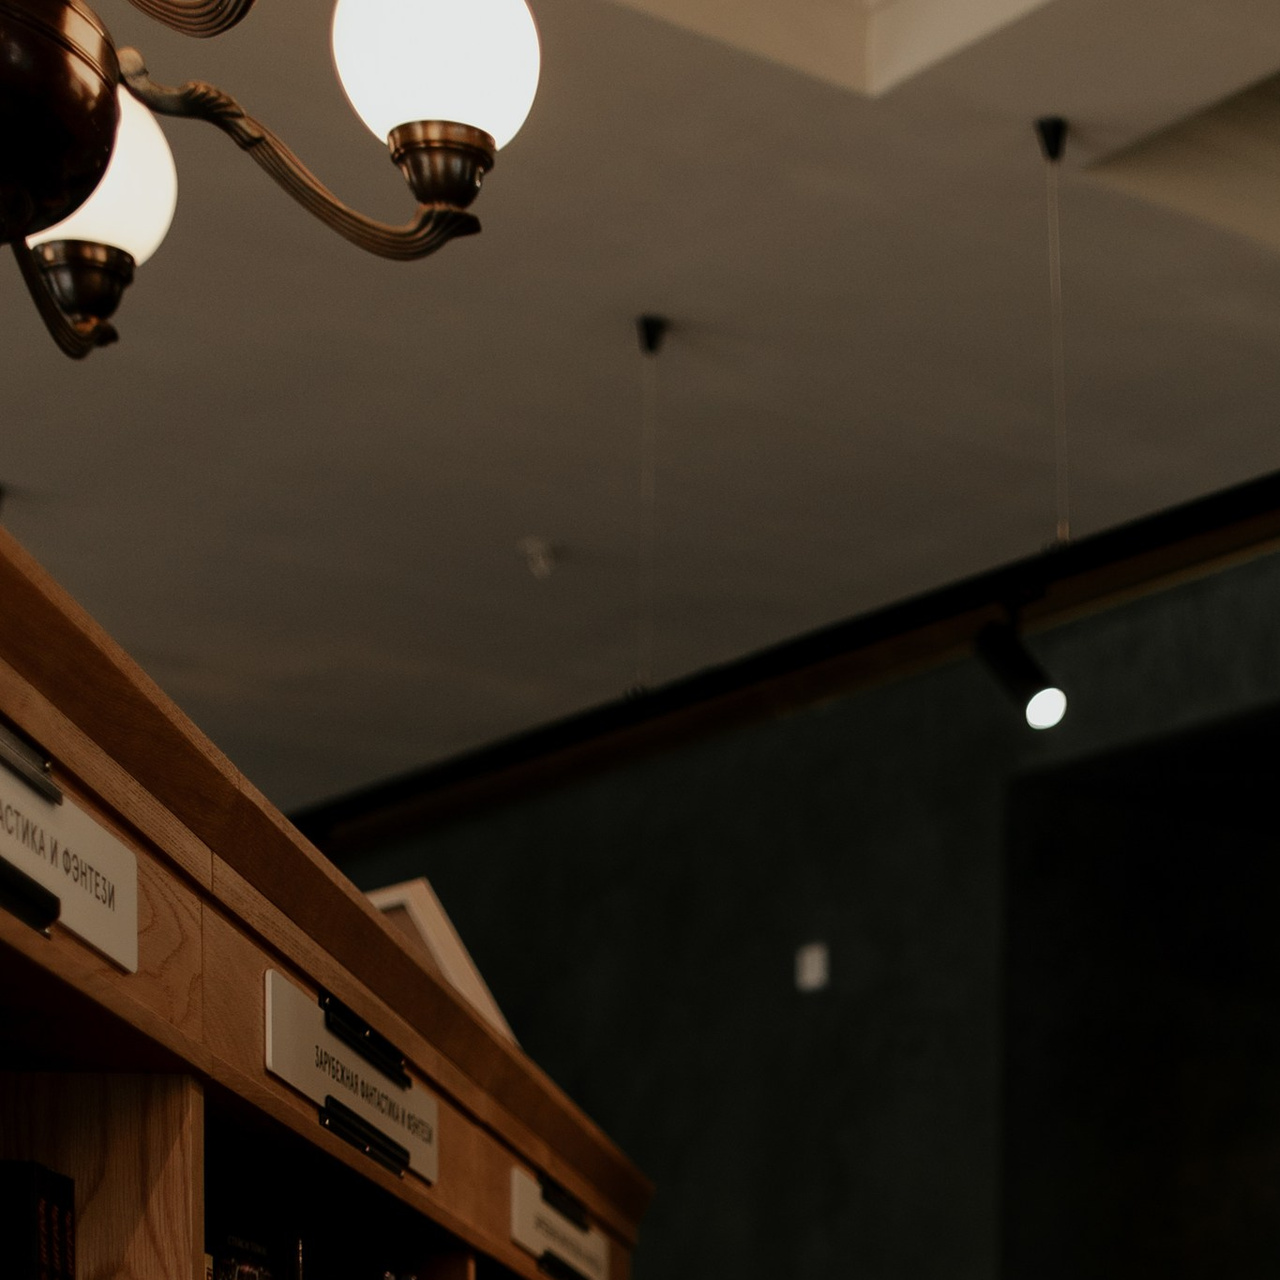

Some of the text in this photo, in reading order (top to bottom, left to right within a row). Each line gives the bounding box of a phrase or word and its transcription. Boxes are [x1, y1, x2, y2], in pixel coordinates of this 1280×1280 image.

[50, 836, 58, 868] И
[62, 846, 116, 912] ФЭНТЕЗИ
[314, 1045, 360, 1098] ЗАРУБЕЖНАЯ
[360, 1078, 400, 1125] ФАНТАСТИКА
